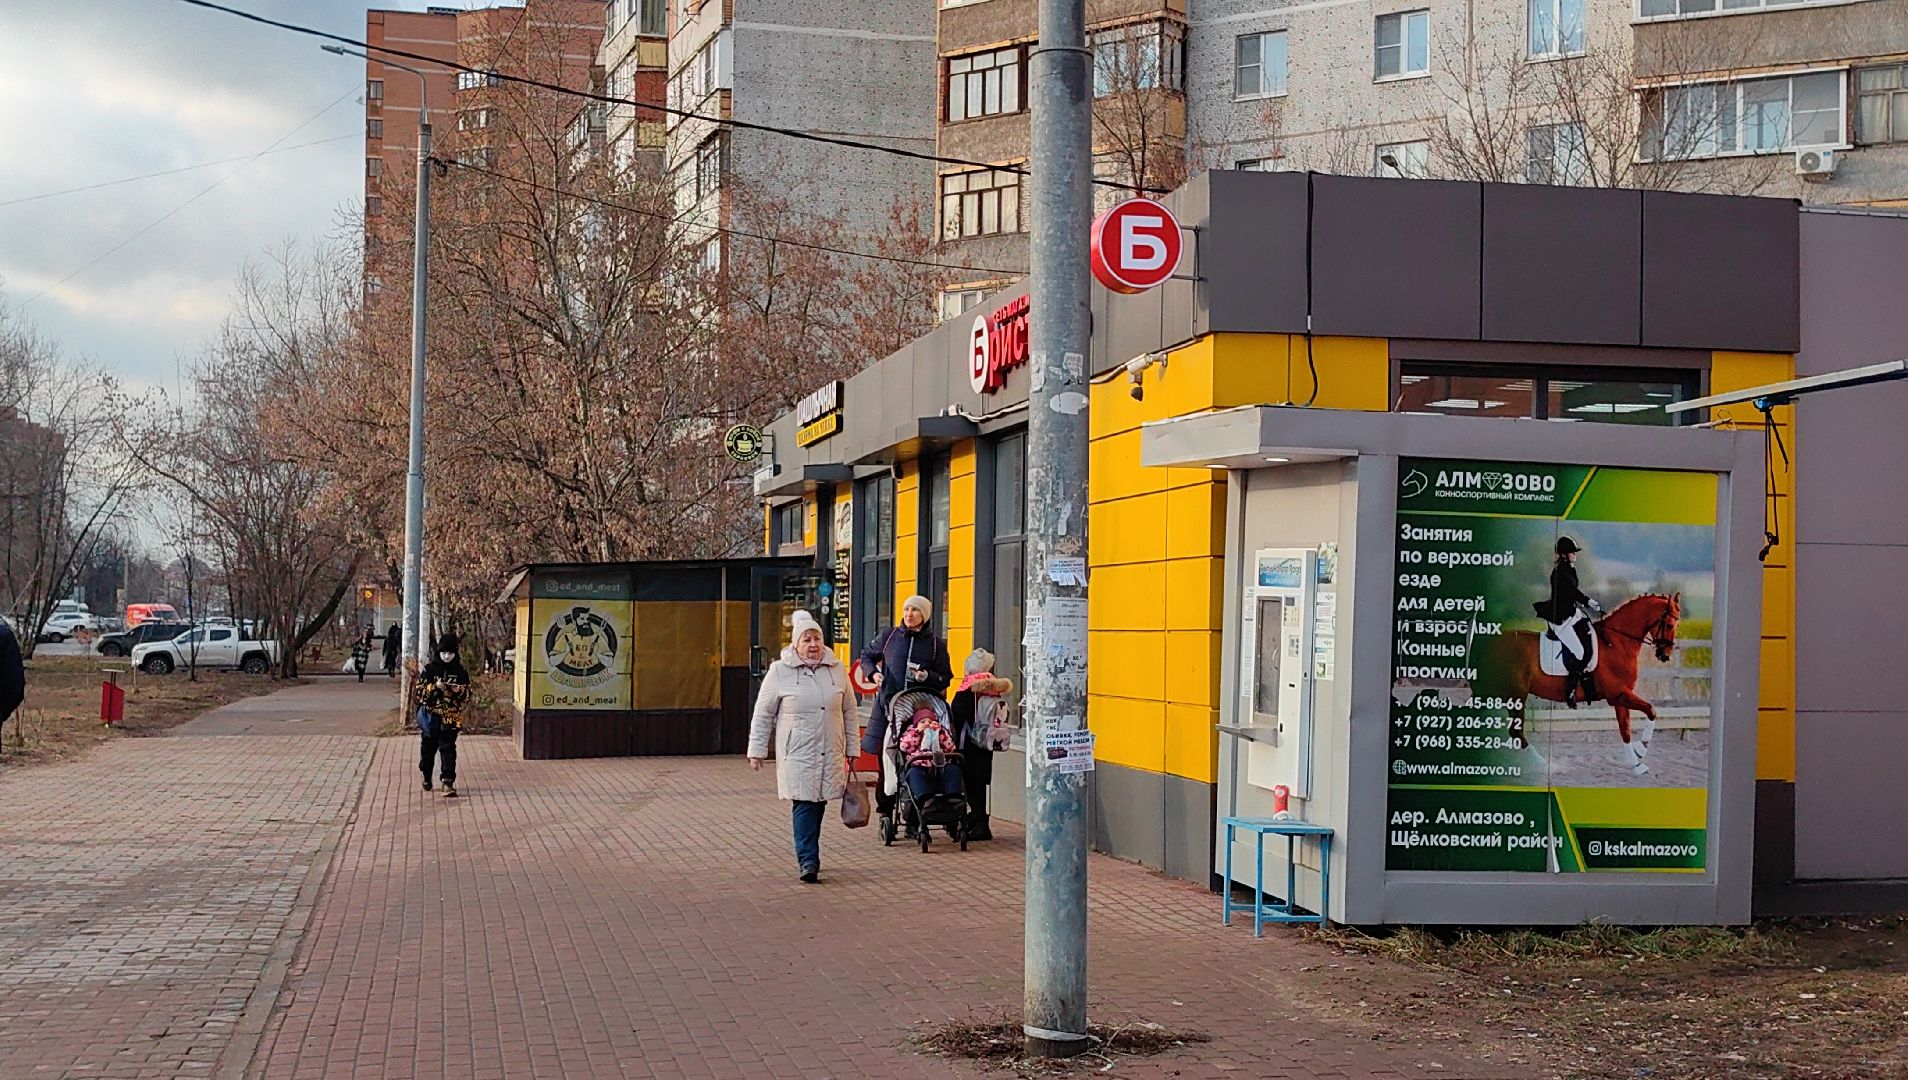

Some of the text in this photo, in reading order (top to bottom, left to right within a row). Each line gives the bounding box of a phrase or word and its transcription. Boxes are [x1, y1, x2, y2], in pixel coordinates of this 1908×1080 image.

[1121, 215, 1167, 270] Б
[1435, 489, 1554, 502] конноспортивный комплекс
[1400, 523, 1473, 542] Занятия
[1400, 550, 1514, 568] по верховой
[1399, 574, 1441, 589] езде
[1398, 595, 1485, 612] для детей
[1397, 620, 1410, 632] и
[1397, 639, 1466, 657] Конные
[556, 695, 617, 706] ed_and_meat
[1457, 696, 1523, 710] 45-88-66
[1394, 715, 1522, 731] +7 (927) 206-93-72
[1394, 735, 1522, 750] +7 (968) 335-28-40
[1407, 761, 1521, 776] www.almazovo.ru
[1391, 810, 1429, 827] дер.
[1391, 830, 1502, 848] Щёлковский
[1604, 841, 1698, 857] kskalmazovo
